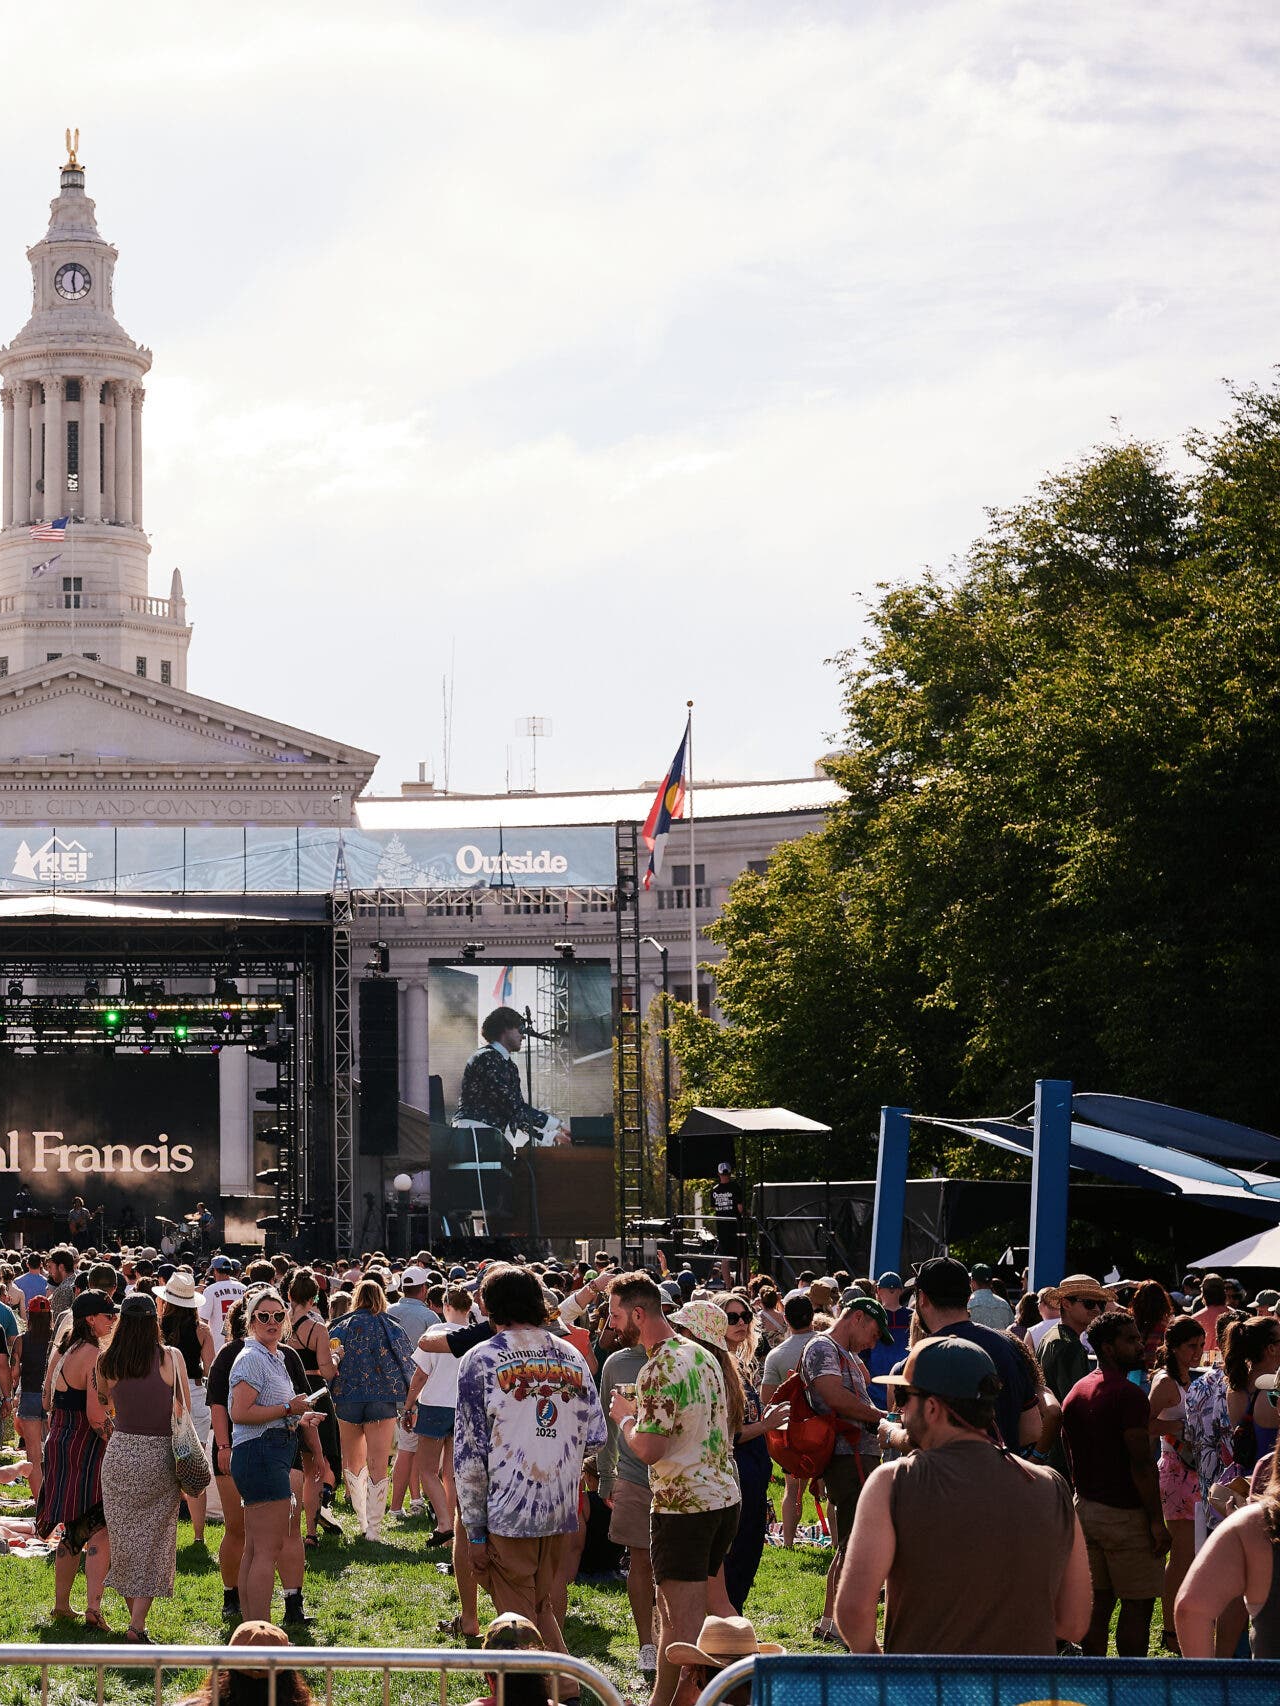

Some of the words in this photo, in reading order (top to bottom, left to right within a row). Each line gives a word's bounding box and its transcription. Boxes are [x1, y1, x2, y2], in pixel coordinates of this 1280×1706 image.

[46, 799, 88, 815] CITY
[94, 799, 136, 815] AND
[228, 799, 257, 815] OF
[260, 799, 336, 815] DENVER
[39, 852, 87, 872] REI
[455, 845, 568, 874] Outside
[31, 1131, 194, 1173] Francis
[214, 1288, 231, 1298] SAM
[497, 1349, 548, 1362] Summer
[550, 1347, 576, 1362] Tour
[535, 1427, 557, 1438] 2023
